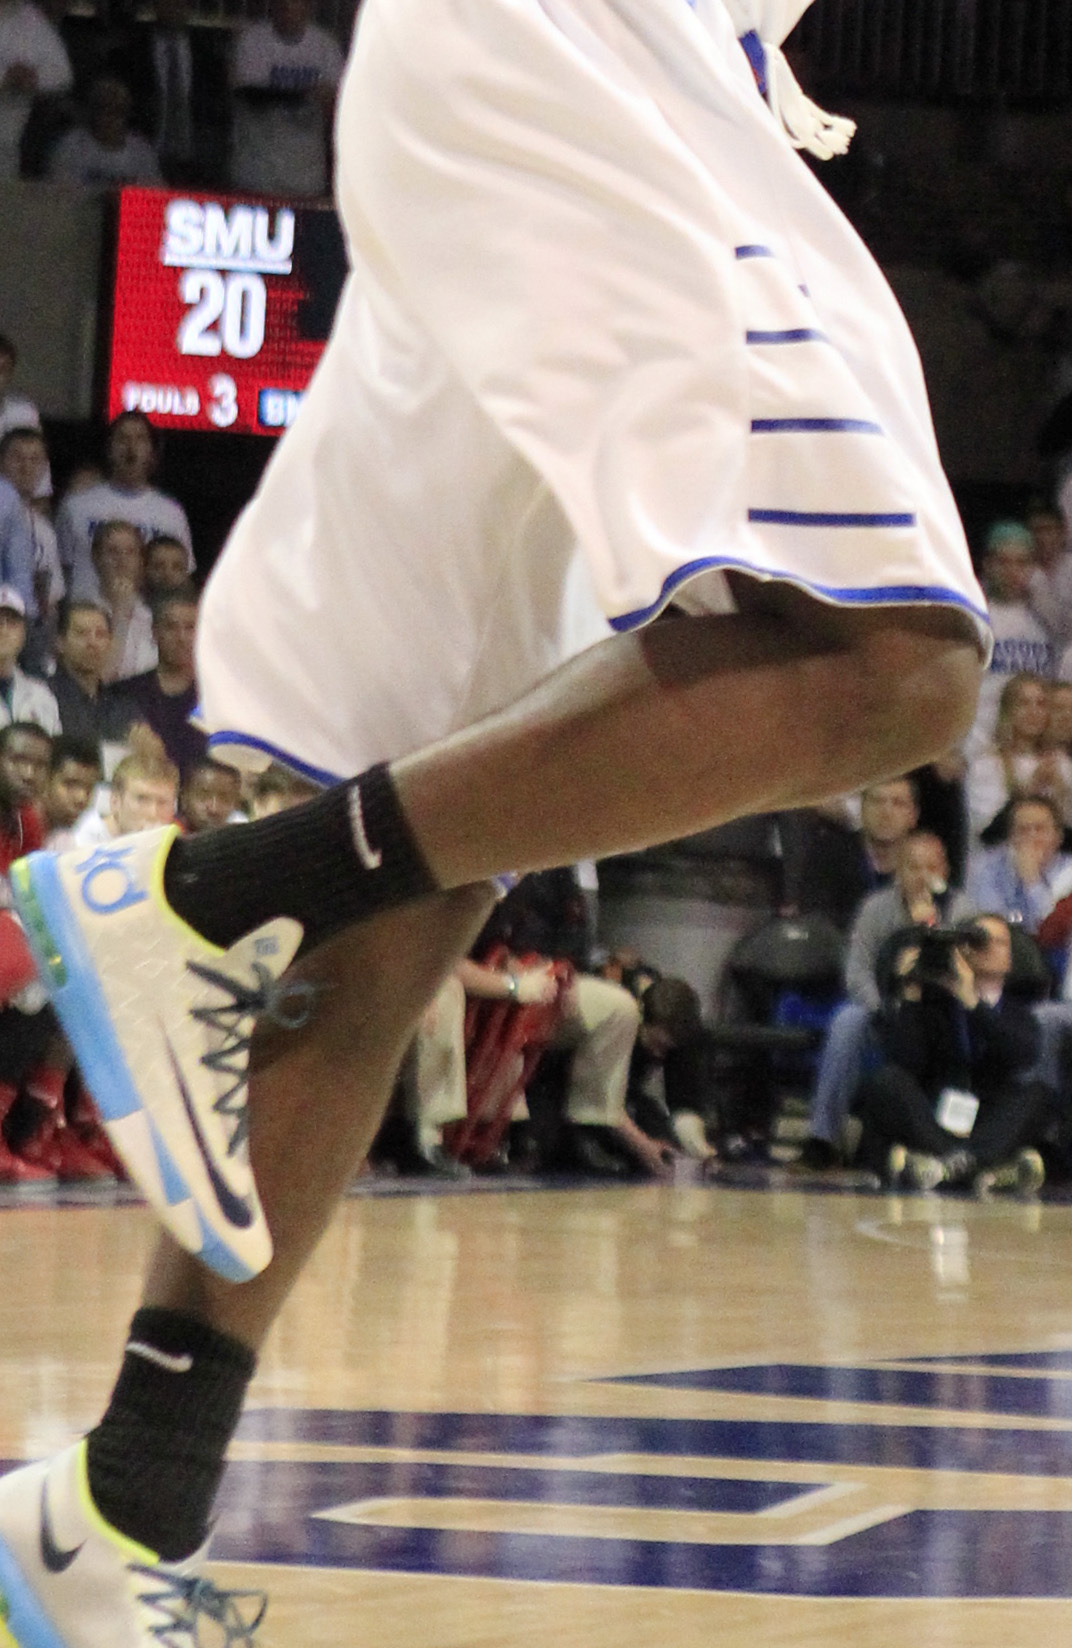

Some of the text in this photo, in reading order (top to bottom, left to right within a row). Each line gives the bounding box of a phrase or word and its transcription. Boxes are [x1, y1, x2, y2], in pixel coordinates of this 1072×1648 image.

[164, 198, 295, 260] SMU
[177, 269, 267, 359] 20
[206, 372, 239, 428] 3
